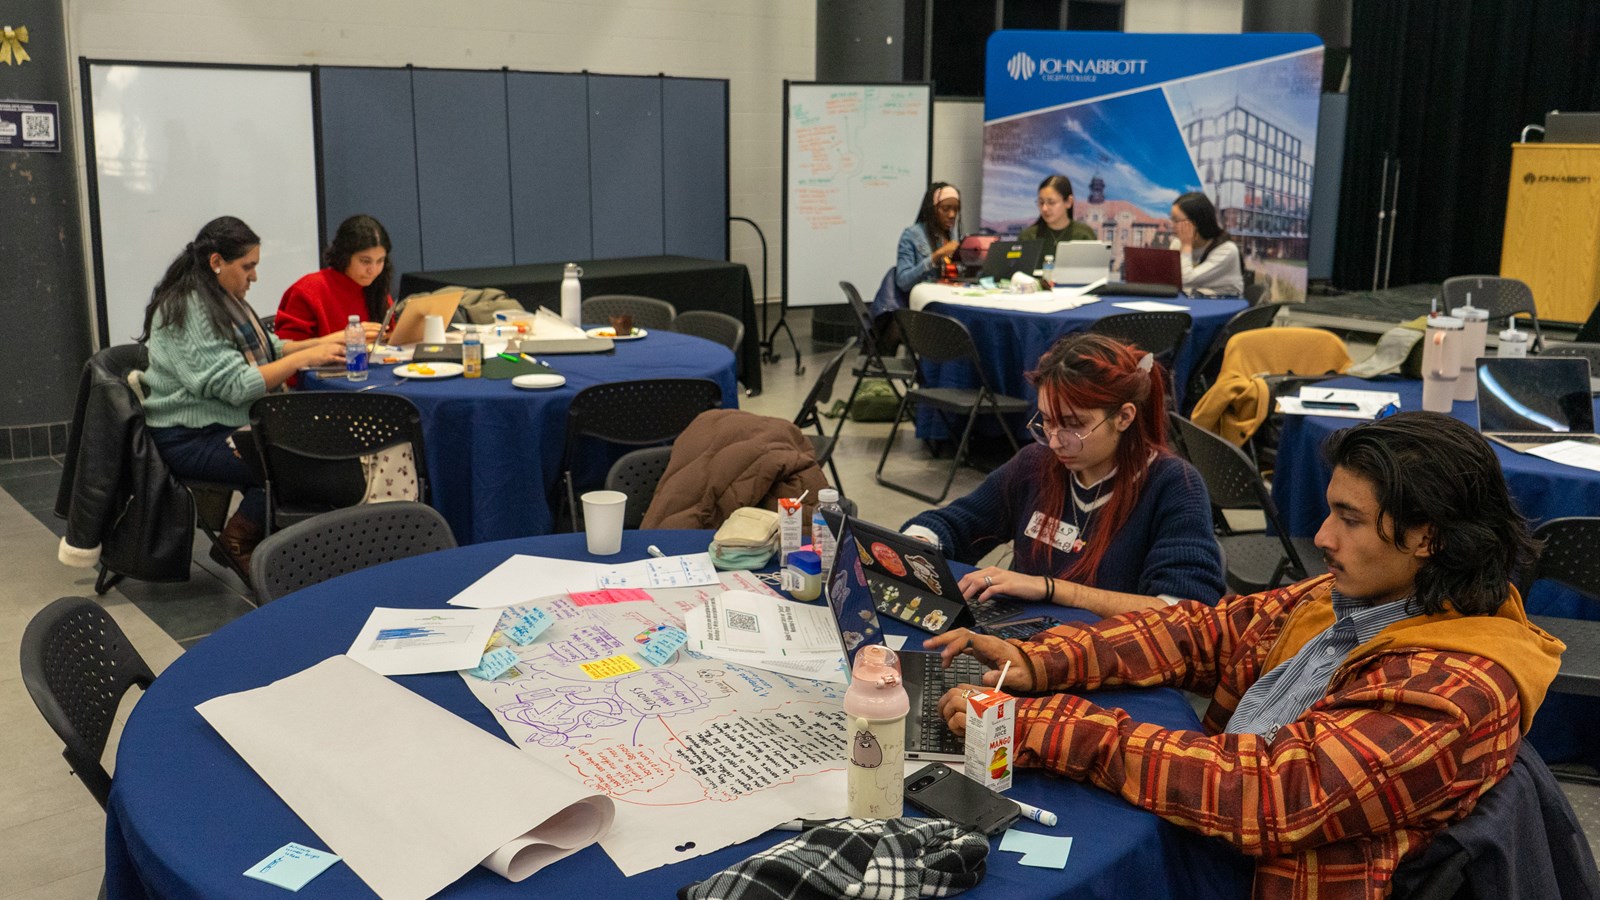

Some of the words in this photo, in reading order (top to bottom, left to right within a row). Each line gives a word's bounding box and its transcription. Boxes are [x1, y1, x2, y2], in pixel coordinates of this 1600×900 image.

[1039, 58, 1084, 75] JOHN
[1084, 58, 1149, 75] ABBOTT
[989, 736, 1011, 750] MANGO
